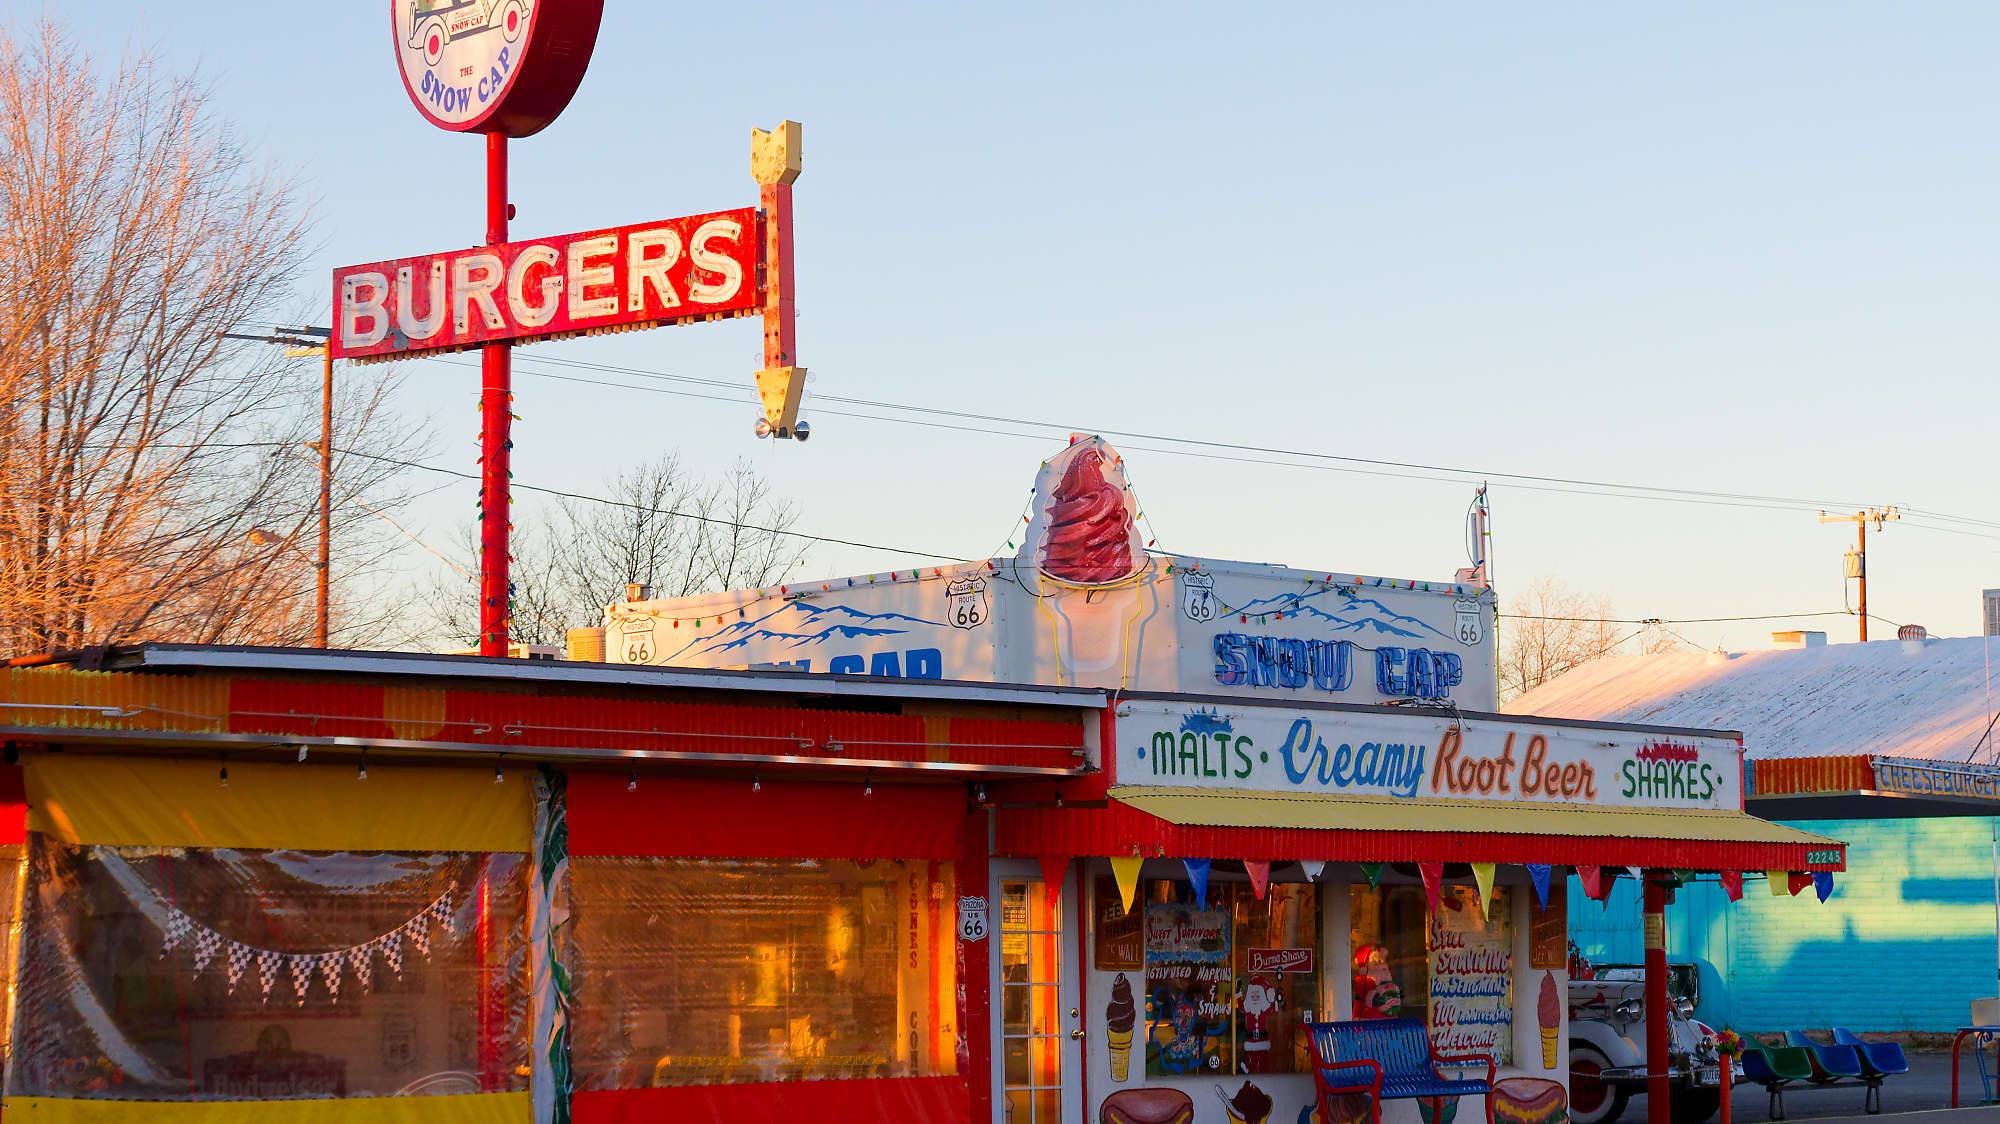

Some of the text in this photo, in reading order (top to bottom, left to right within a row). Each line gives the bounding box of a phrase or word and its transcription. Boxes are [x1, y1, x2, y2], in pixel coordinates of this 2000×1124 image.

[451, 15, 484, 33] SNOW CAP
[421, 46, 510, 113] SNOW CAP
[460, 65, 473, 77] THE
[341, 219, 743, 349] BURGERS
[957, 604, 980, 625] 66
[1191, 598, 1210, 618] 66
[1461, 623, 1477, 642] 66
[628, 642, 649, 662] 66
[1213, 632, 1464, 698] SNOW CAP
[1151, 716, 1715, 801] MALTS Creamy Root Beer SHAKES
[1807, 850, 1841, 865] 22245
[961, 900, 985, 910] ARIZONA
[964, 920, 984, 936] 66
[1119, 943, 1140, 962] WALL
[1170, 966, 1192, 979] USED
